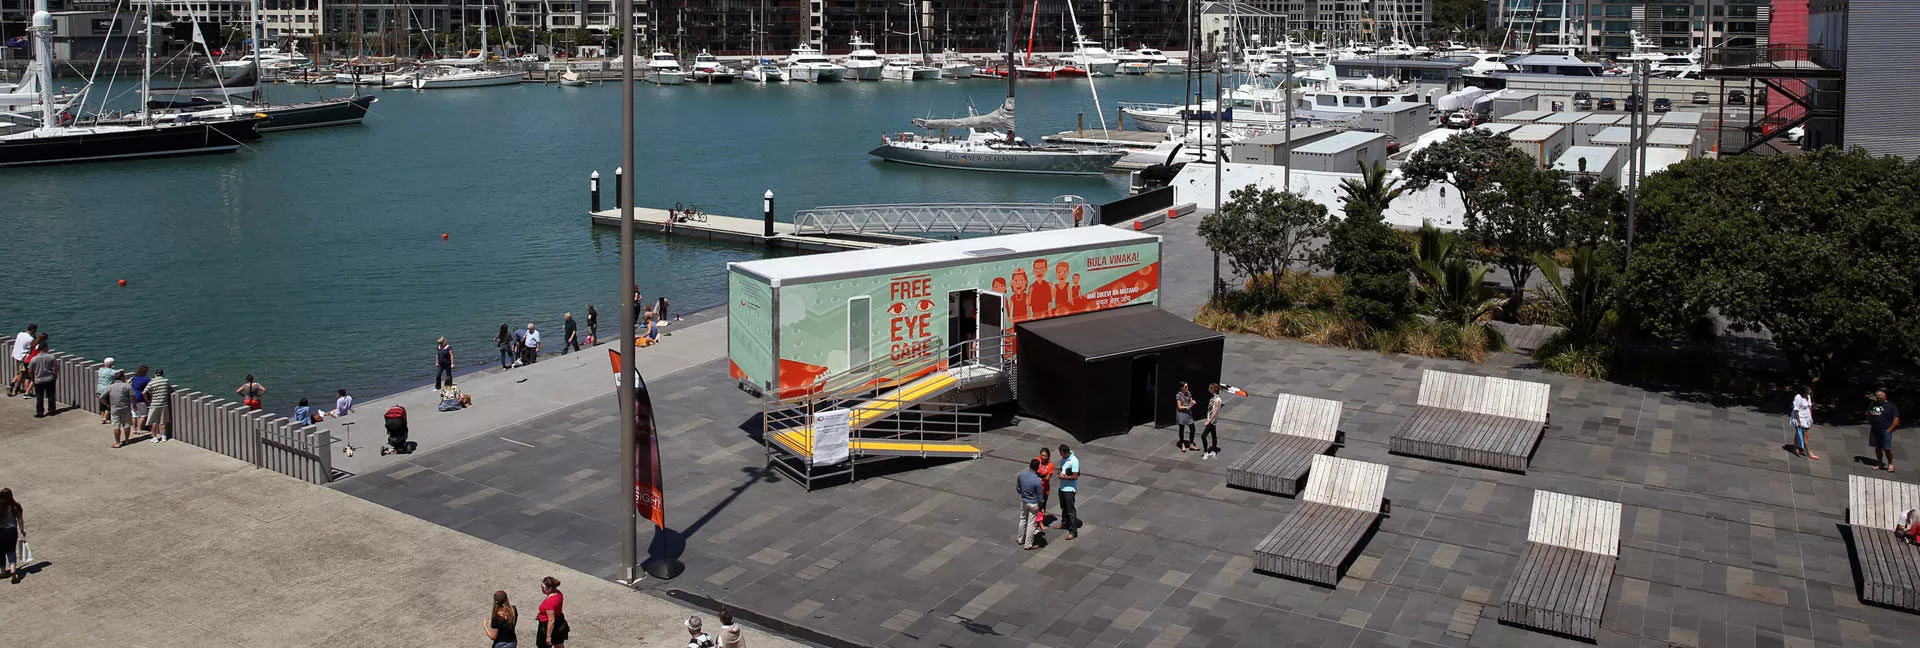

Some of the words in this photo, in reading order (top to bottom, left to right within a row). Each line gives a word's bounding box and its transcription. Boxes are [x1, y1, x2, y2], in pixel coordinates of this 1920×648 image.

[1087, 257, 1107, 267] BULA
[1110, 252, 1139, 264] VINAKA!
[890, 278, 932, 300] FREE
[891, 313, 931, 342] EYE
[891, 340, 932, 361] CARE
